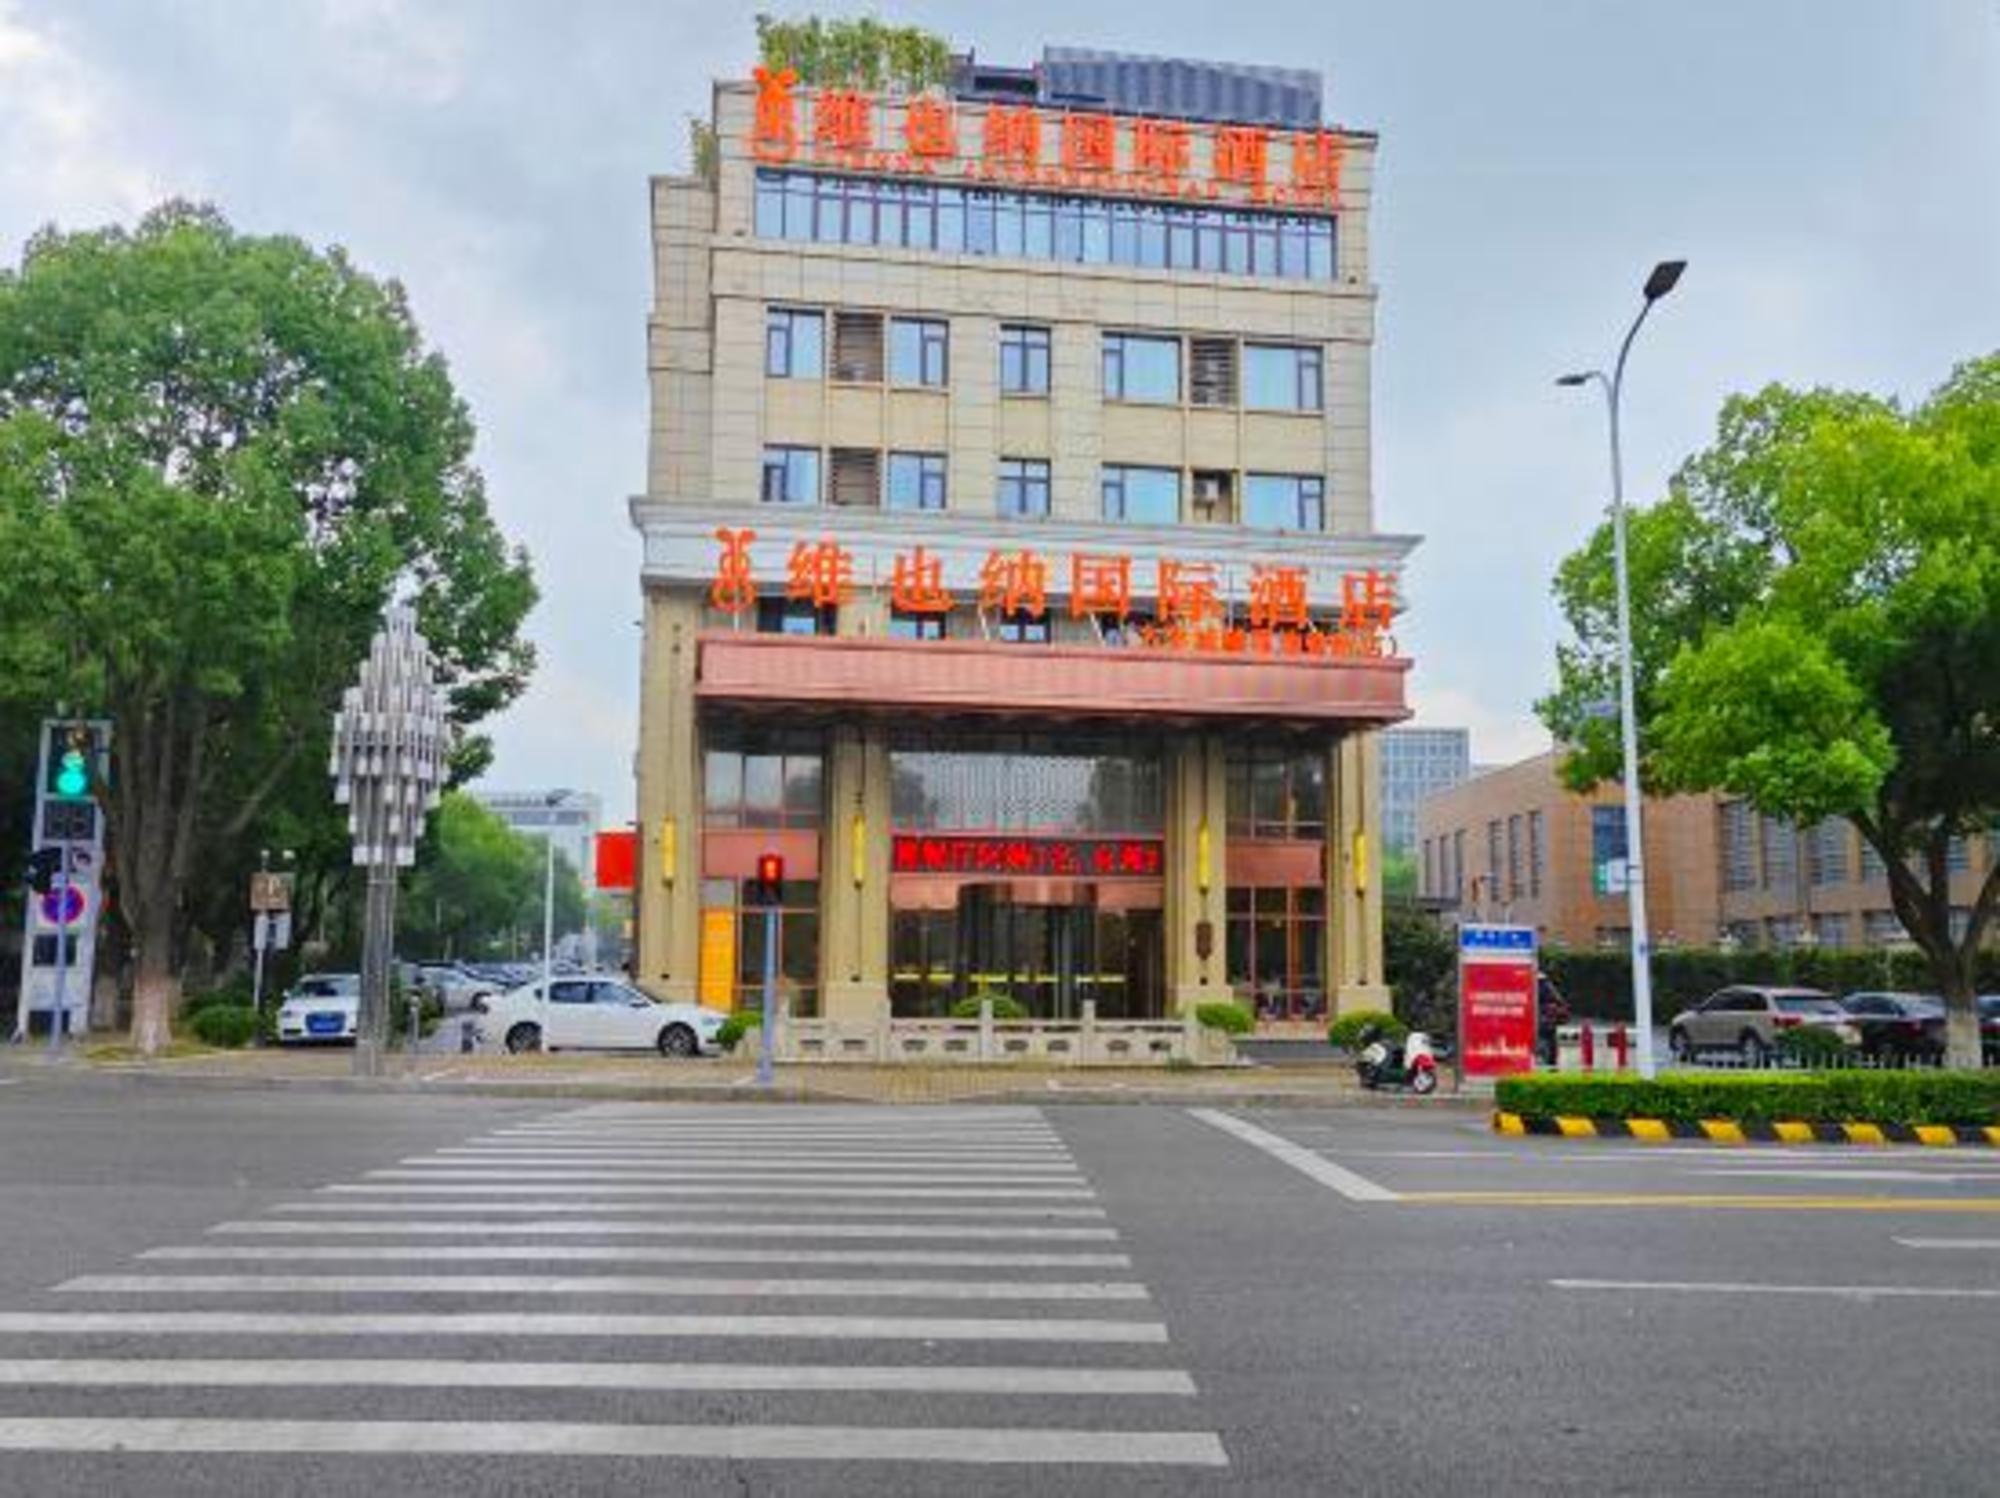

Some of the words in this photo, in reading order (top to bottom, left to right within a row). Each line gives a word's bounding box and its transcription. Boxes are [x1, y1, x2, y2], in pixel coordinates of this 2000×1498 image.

[813, 91, 1341, 195] 维也纳国际酒店
[786, 540, 1397, 627] 维也纳国际酒店
